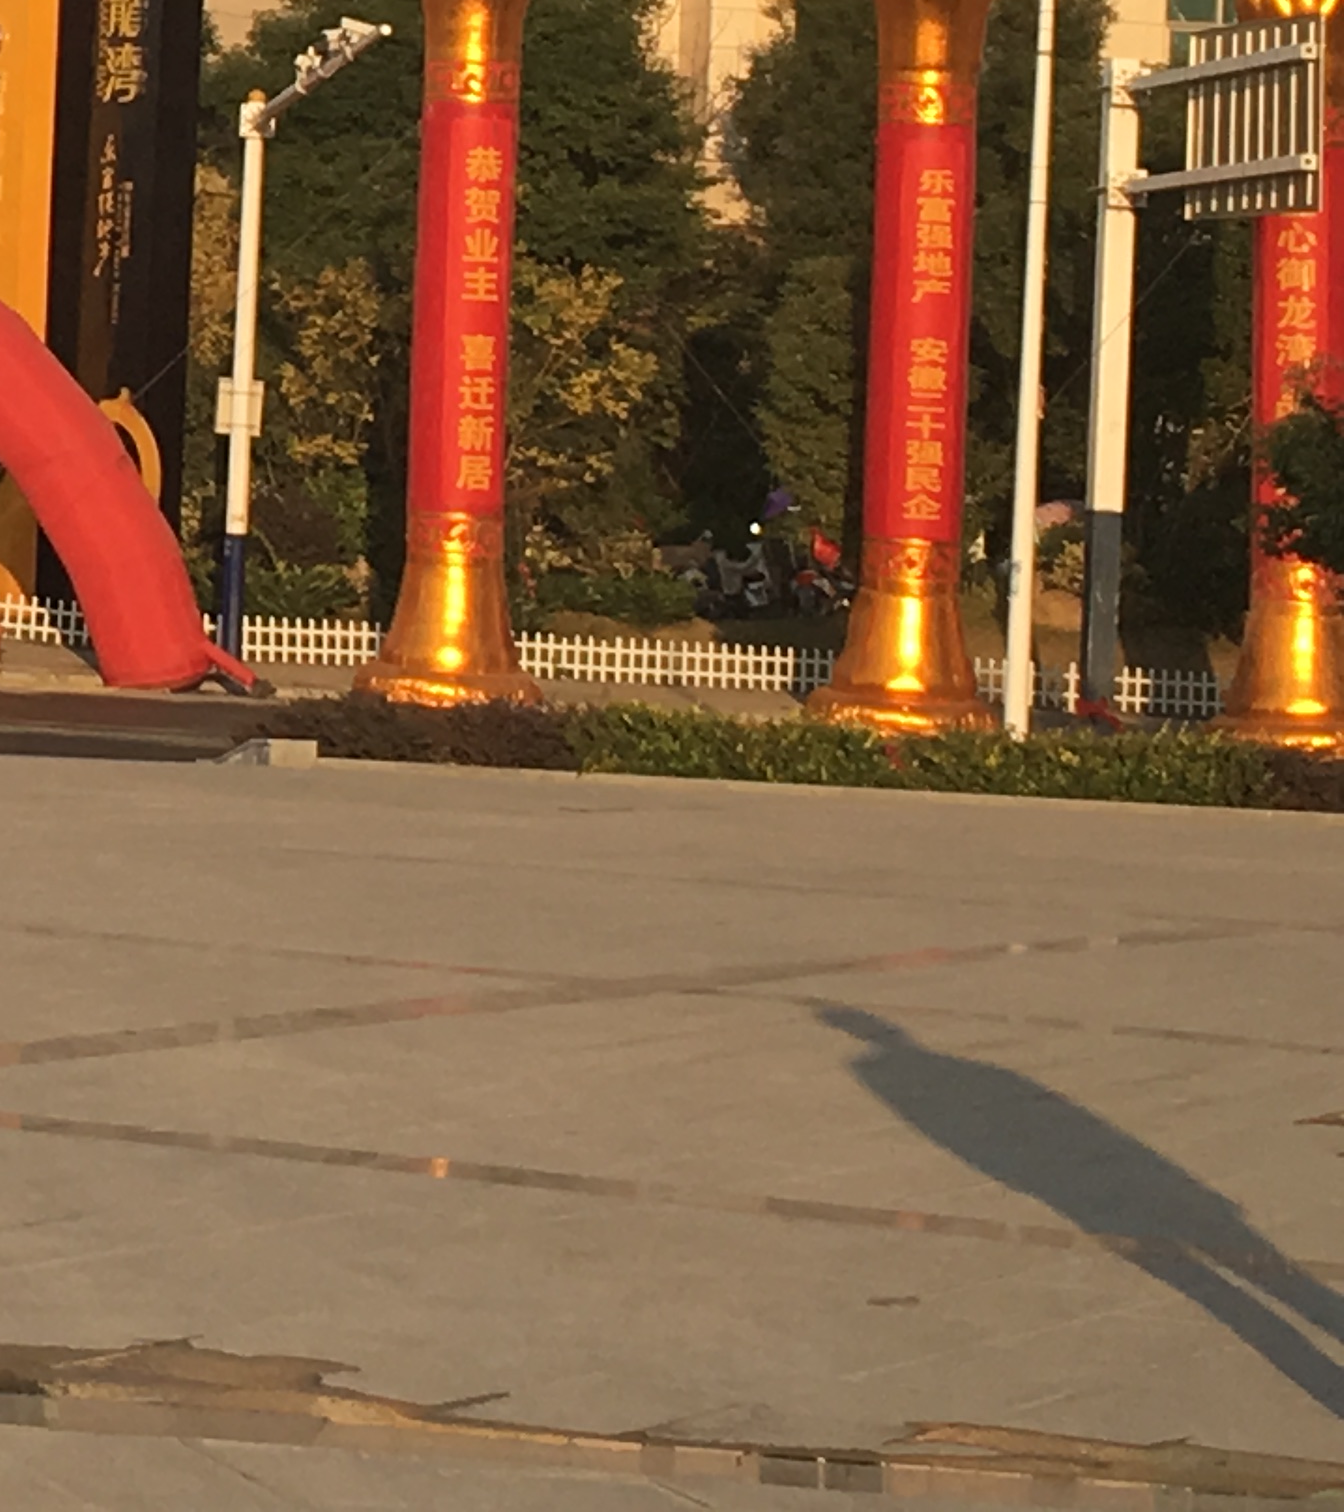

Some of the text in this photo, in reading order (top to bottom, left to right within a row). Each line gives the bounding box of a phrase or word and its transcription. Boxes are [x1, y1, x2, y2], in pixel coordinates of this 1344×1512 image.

[456, 145, 503, 492] 恭贺业主 喜迁新居
[902, 168, 956, 521] 乐富强地产 安徽二十强民企
